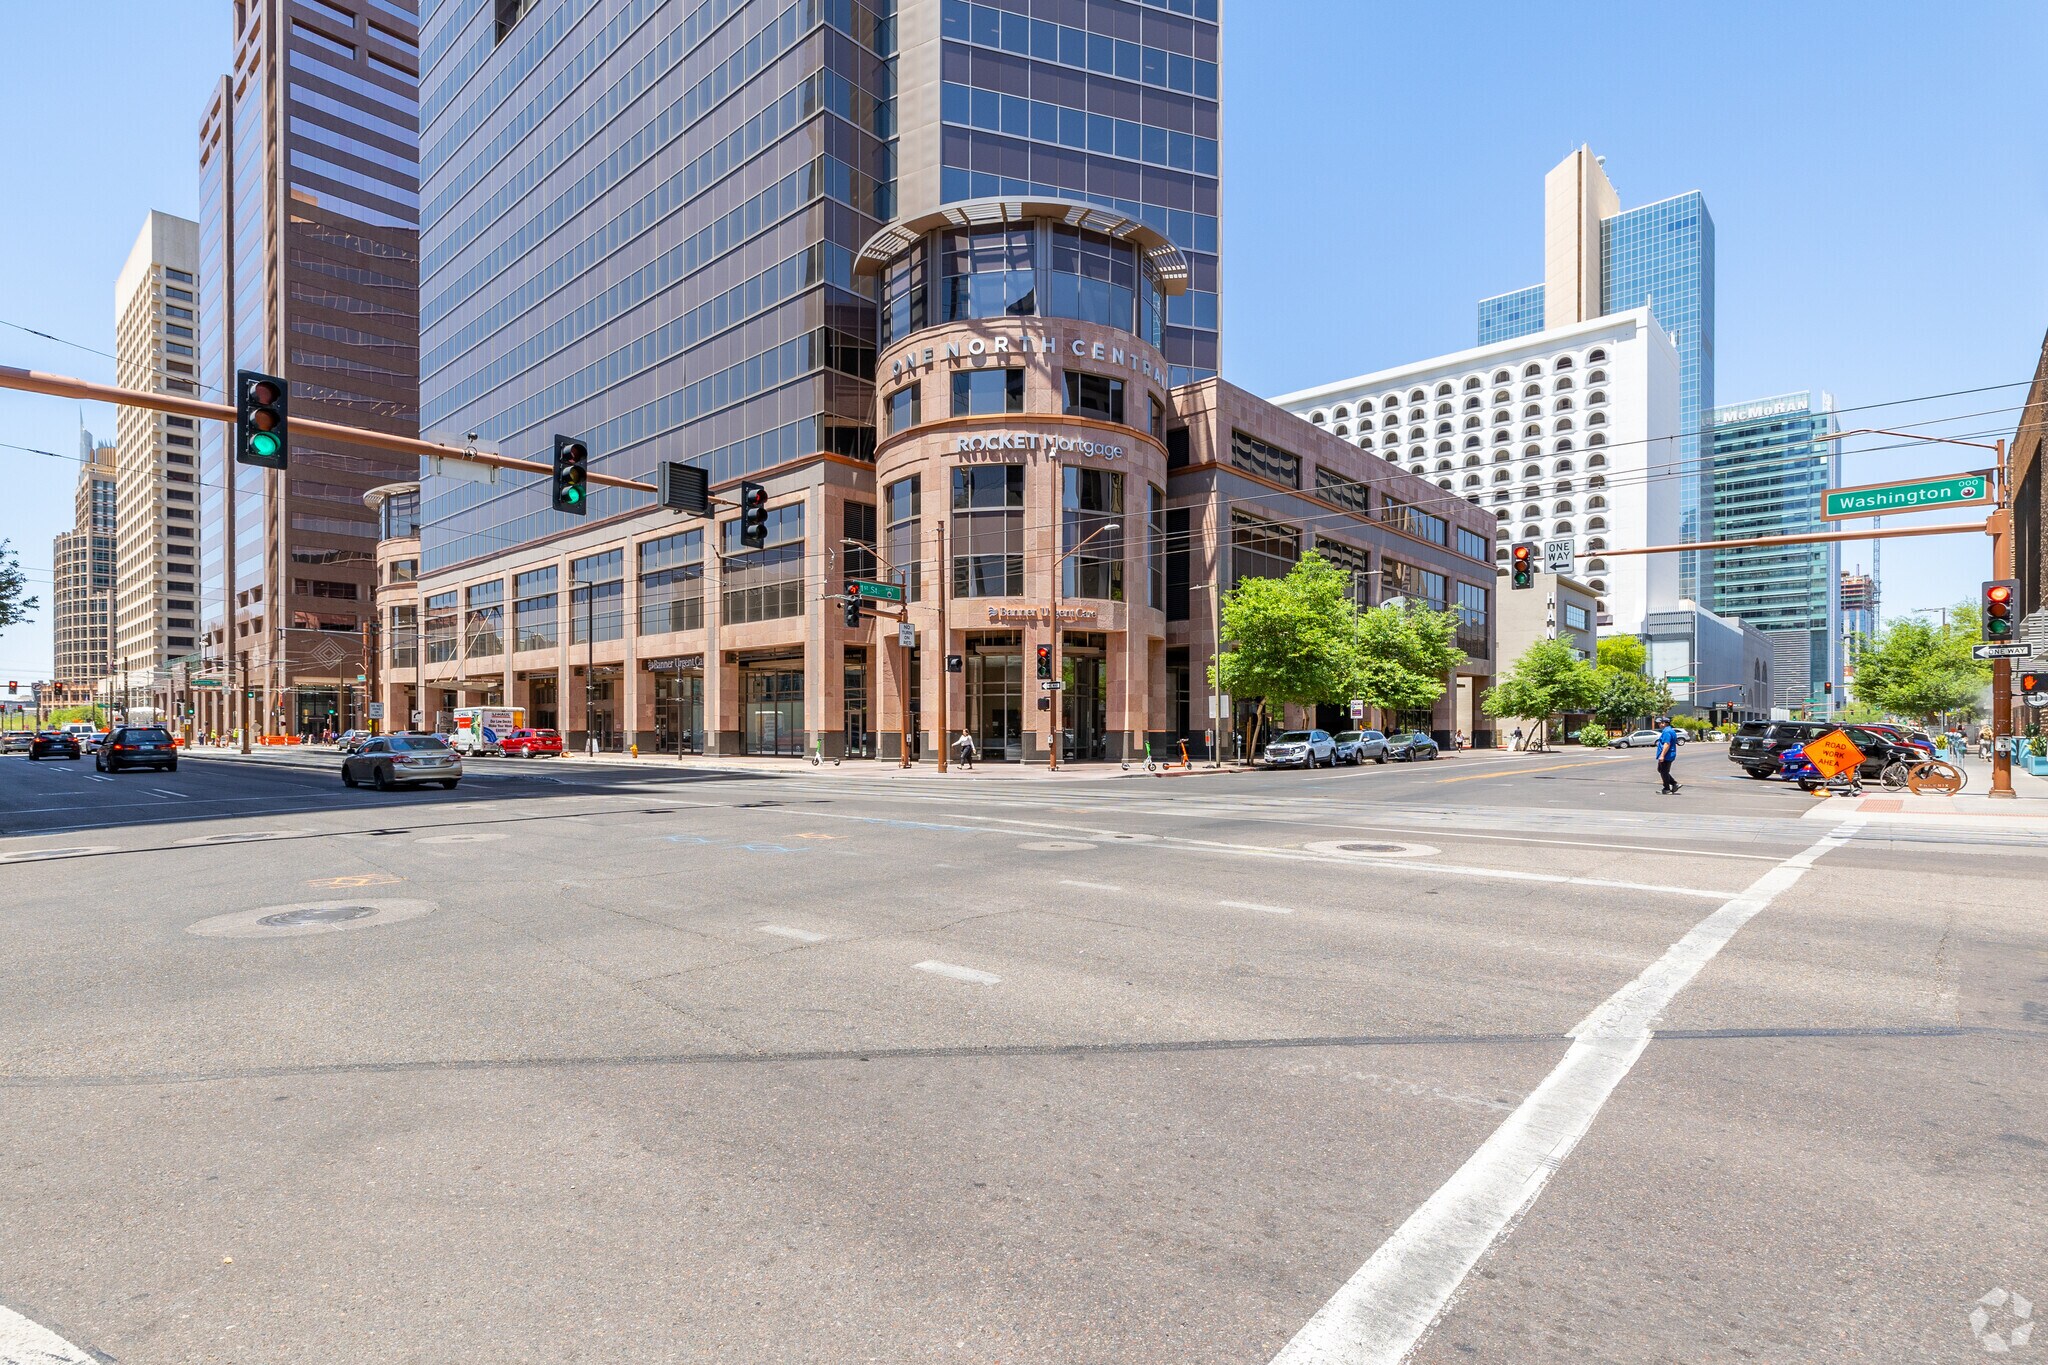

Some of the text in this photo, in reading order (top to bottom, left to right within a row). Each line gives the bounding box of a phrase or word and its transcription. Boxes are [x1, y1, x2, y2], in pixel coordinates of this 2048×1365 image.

[892, 336, 1164, 387] ONE NORTH CENTRAL
[1723, 400, 1808, 423] McMoRAN
[957, 432, 1123, 461] ROCKET Mortgage
[1840, 488, 1950, 509] Washington
[1548, 542, 1570, 552] ONE
[1548, 552, 1570, 561] WAY
[1000, 607, 1097, 619] Banner Ugent Care
[654, 660, 673, 669] Banner
[1825, 741, 1846, 750] ROAD
[1822, 750, 1845, 758] WORK
